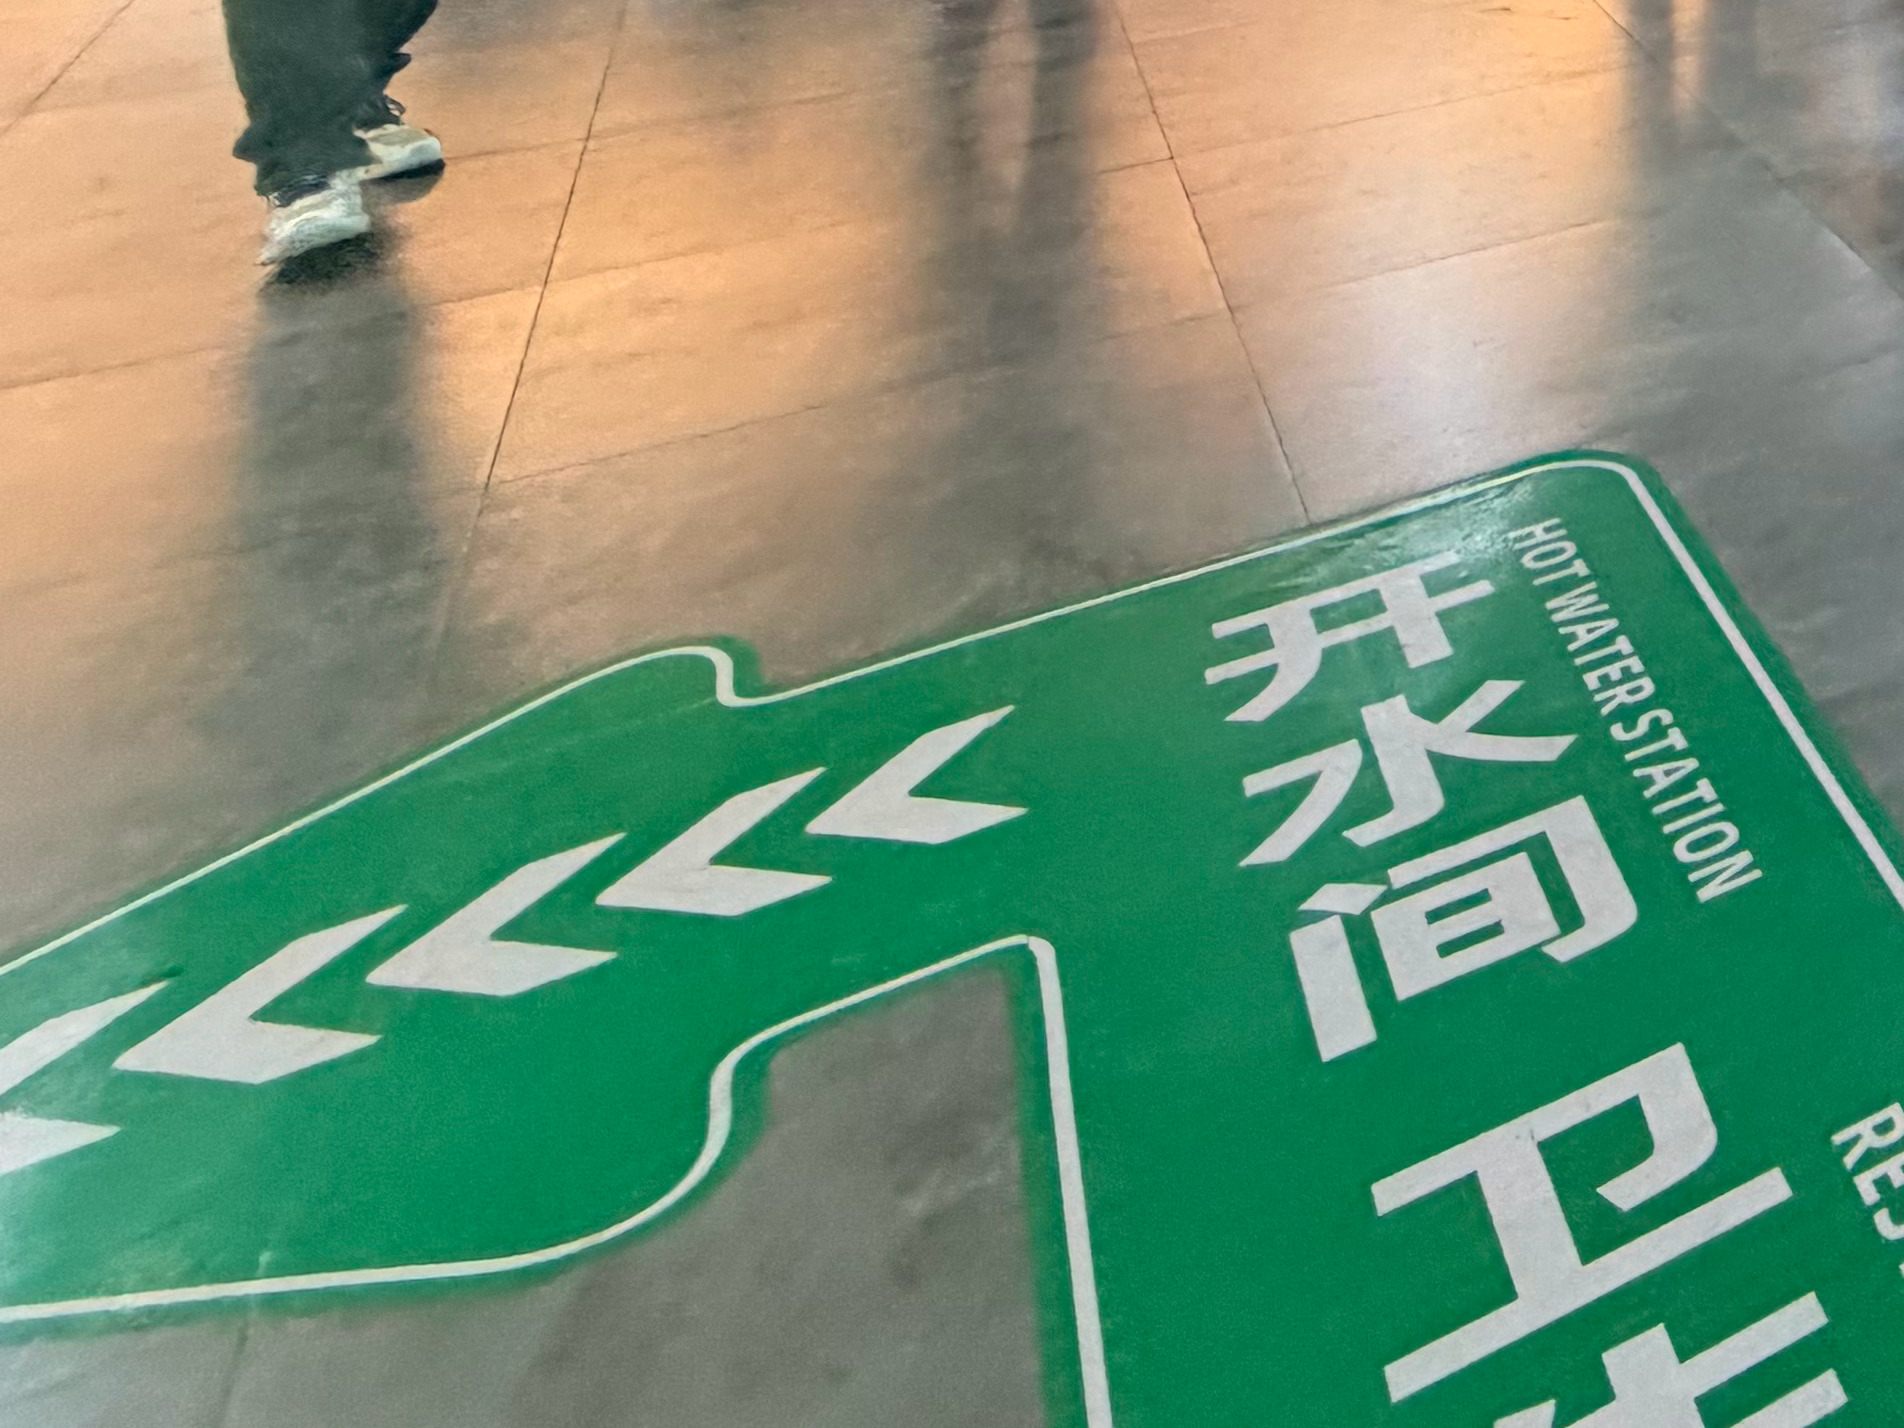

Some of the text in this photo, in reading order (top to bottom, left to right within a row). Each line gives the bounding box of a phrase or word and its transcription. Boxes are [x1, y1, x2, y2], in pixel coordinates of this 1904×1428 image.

[1203, 549, 1639, 1064] 开水间
[1507, 517, 1763, 904] HOT WATER STATION
